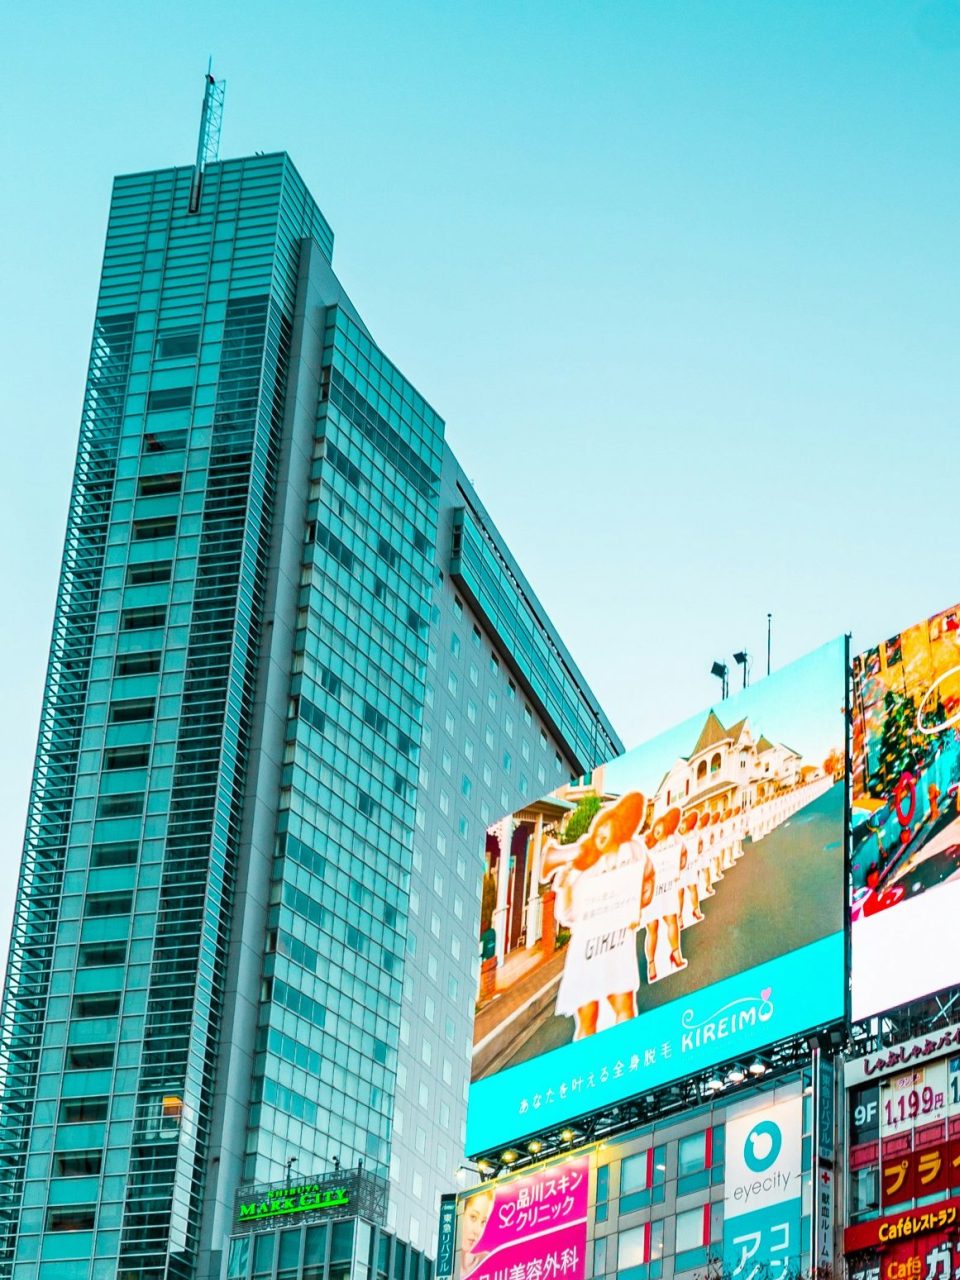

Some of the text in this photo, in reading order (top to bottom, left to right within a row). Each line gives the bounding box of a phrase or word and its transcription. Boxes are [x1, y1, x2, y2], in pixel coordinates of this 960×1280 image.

[681, 998, 775, 1054] KIREIMO
[518, 1043, 674, 1115] あなたを叶える全身脱毛
[854, 1102, 878, 1127] 9F
[240, 1188, 347, 1216] MARK CITY
[267, 1184, 320, 1199] SHIBUYA
[516, 1170, 583, 1210] 品川スキン
[733, 1170, 792, 1202] eyecity
[516, 1198, 575, 1233] クリニック
[440, 1213, 452, 1273] 東急リバブル
[888, 1256, 922, 1279] Café
